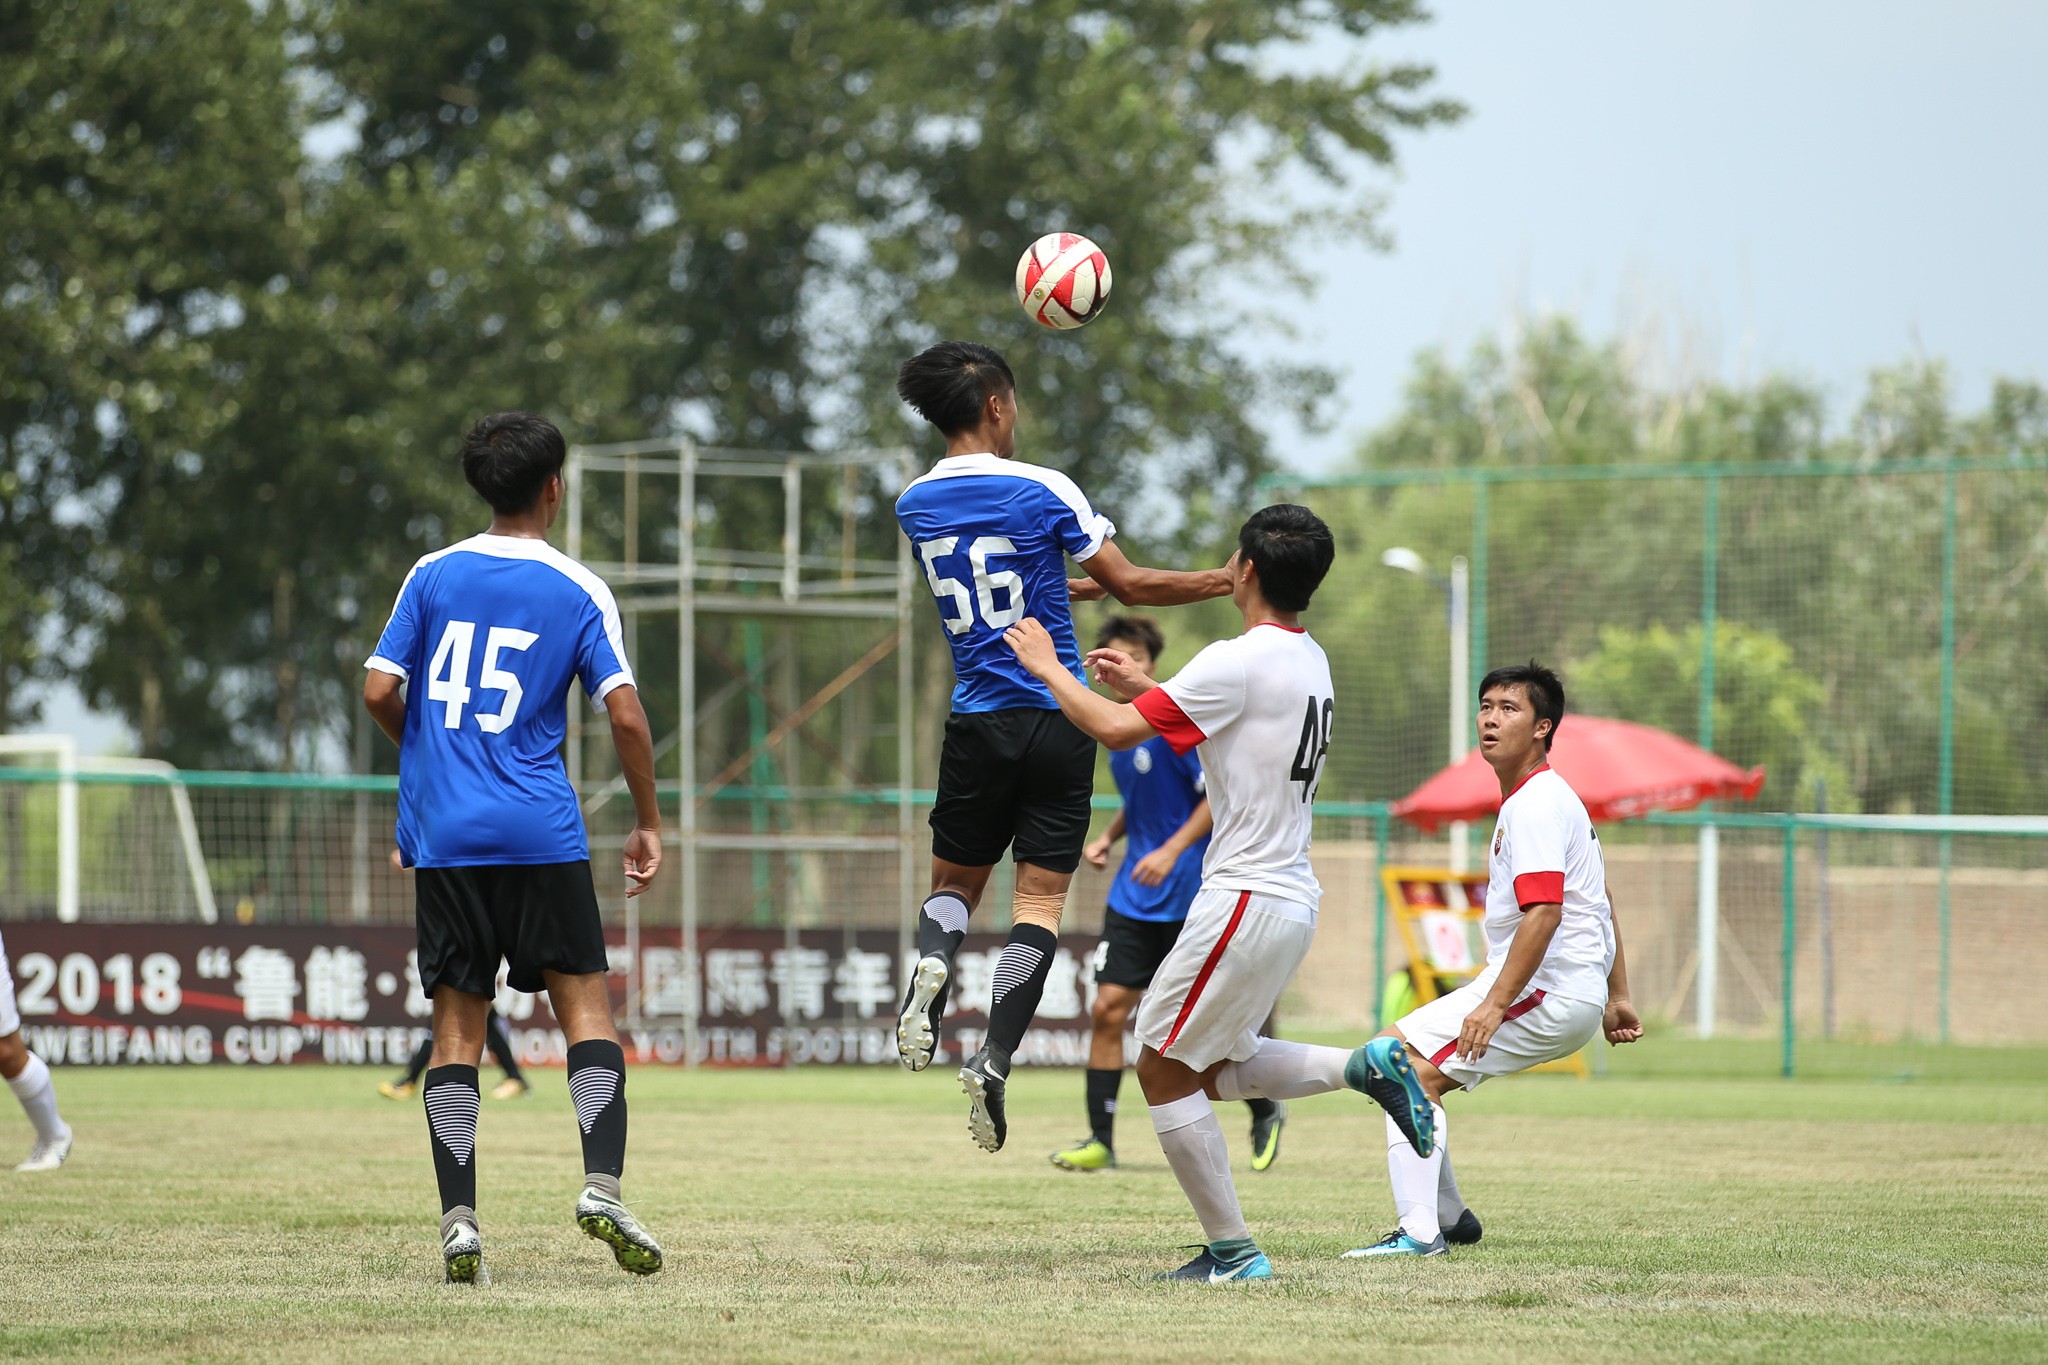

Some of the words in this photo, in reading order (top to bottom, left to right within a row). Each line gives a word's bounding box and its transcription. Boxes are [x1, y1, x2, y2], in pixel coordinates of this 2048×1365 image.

[918, 536, 1026, 635] 56
[428, 619, 540, 735] 45
[1289, 695, 1334, 805] 48
[16, 951, 182, 1015] 2018
